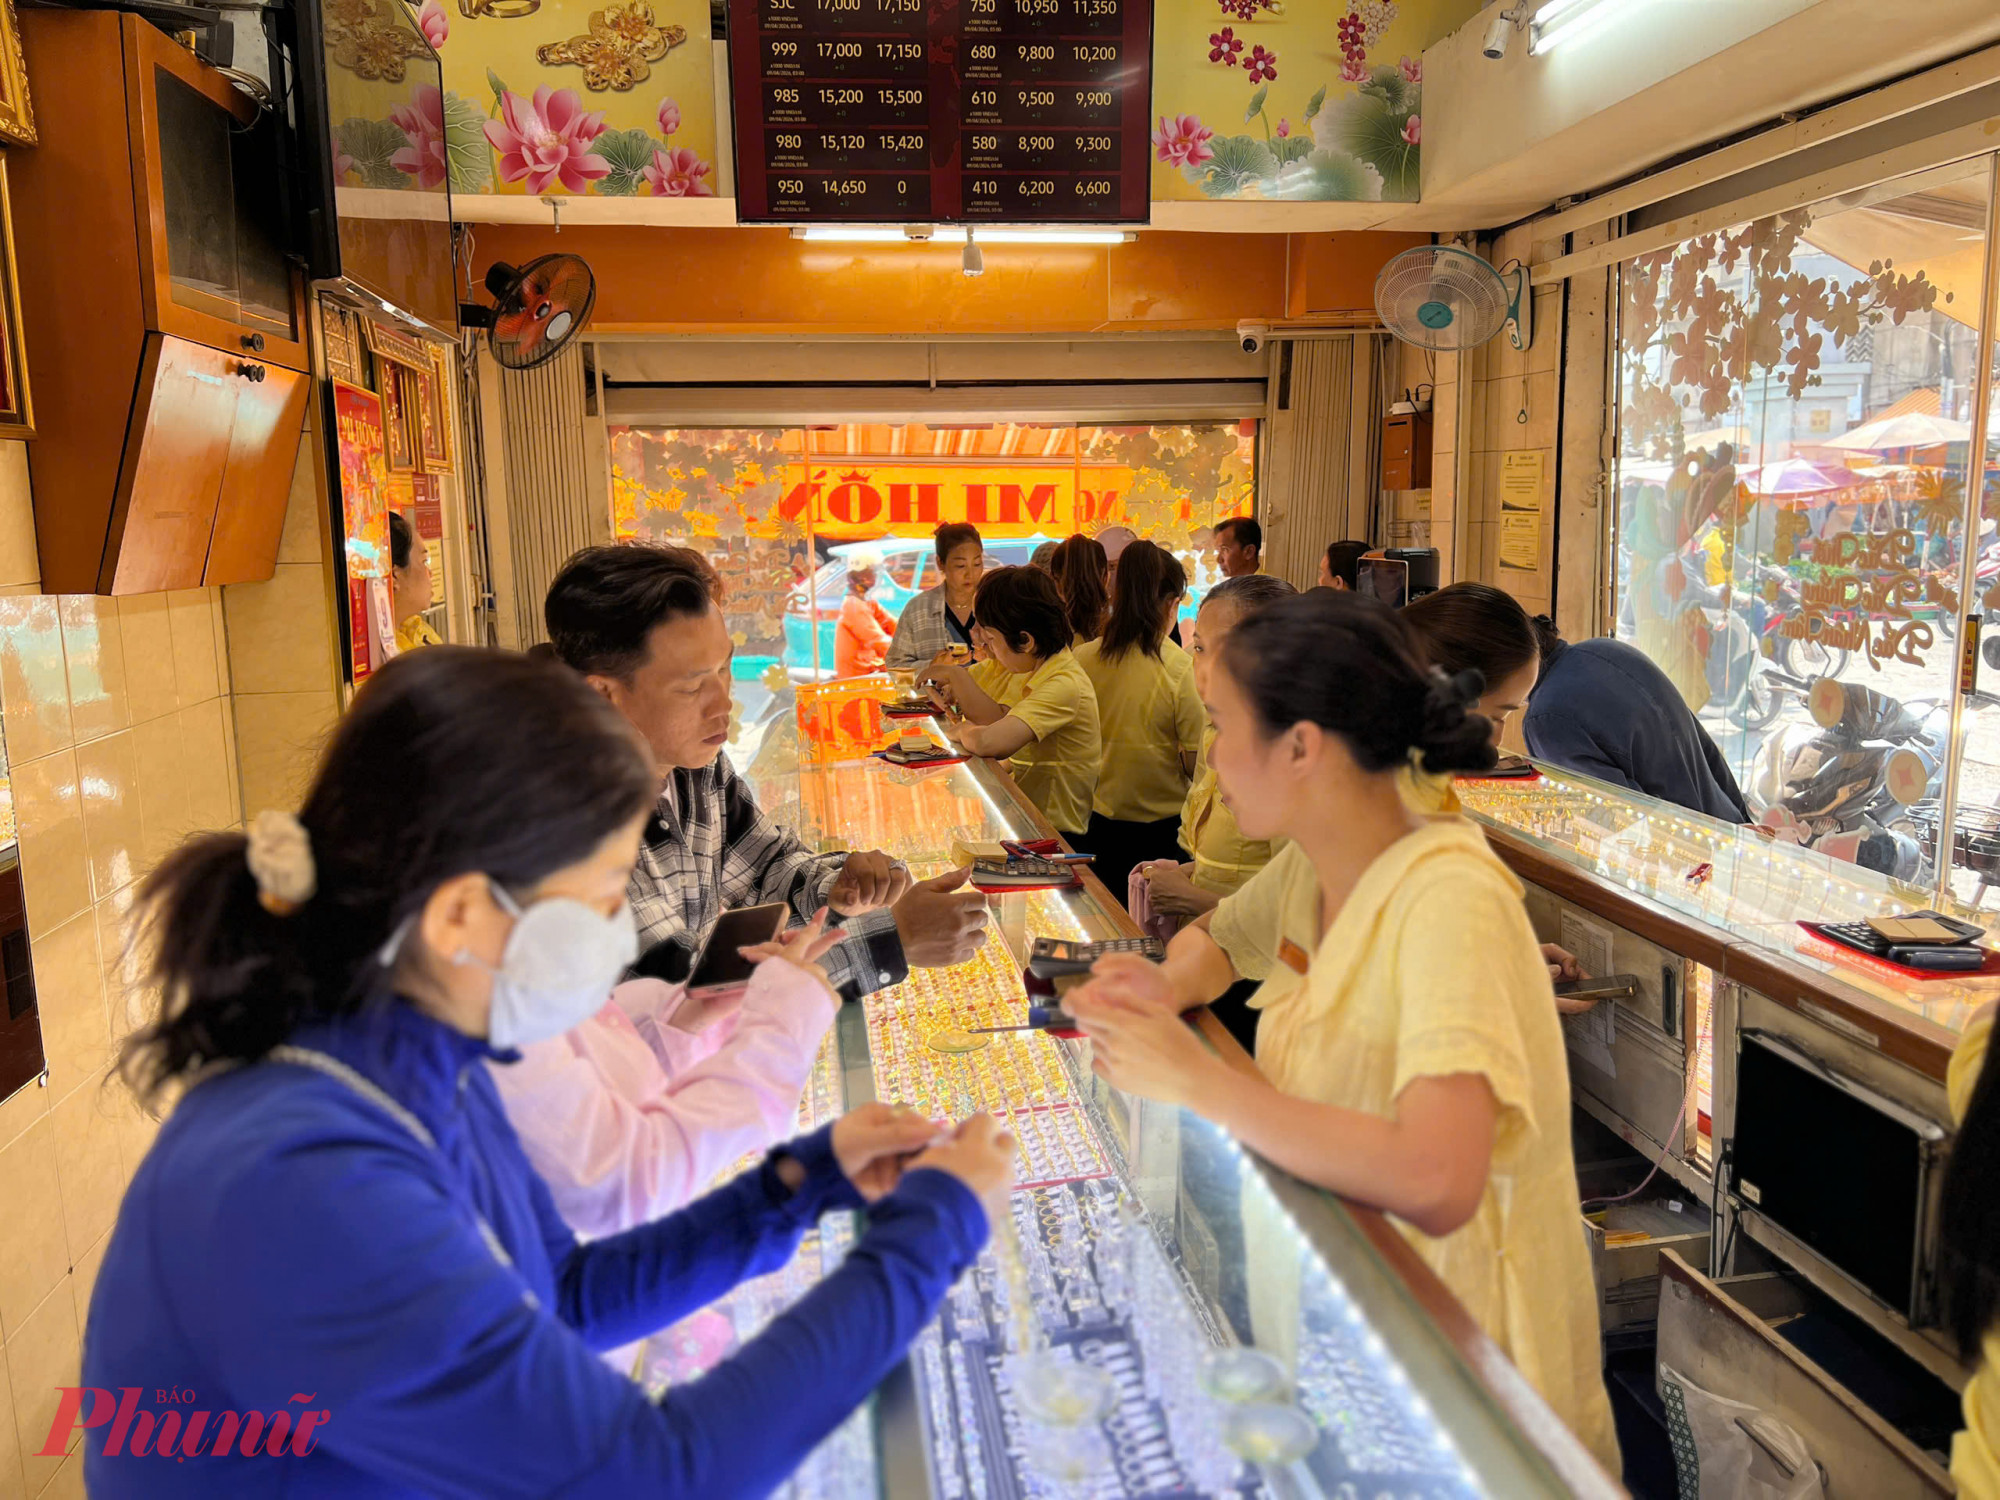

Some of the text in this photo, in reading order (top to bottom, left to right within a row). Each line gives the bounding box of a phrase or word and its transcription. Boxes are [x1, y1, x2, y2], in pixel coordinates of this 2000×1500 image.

[771, 0, 920, 13] SJC 17,000 17,150
[971, 0, 1116, 16] 750 10,950 11,350
[772, 43, 921, 60] 999 17,000 17,150
[971, 45, 1115, 62] 680 9,800 10,200
[774, 89, 922, 106] 985 15,200 15,500
[971, 91, 1111, 108] 610 9,500 9,900
[776, 135, 923, 152] 980 15,120 15,420
[972, 136, 1111, 152] 580 8,900 9,300
[778, 180, 906, 196] 950 14,650 0
[973, 181, 1111, 196] 410 6,200 6,600
